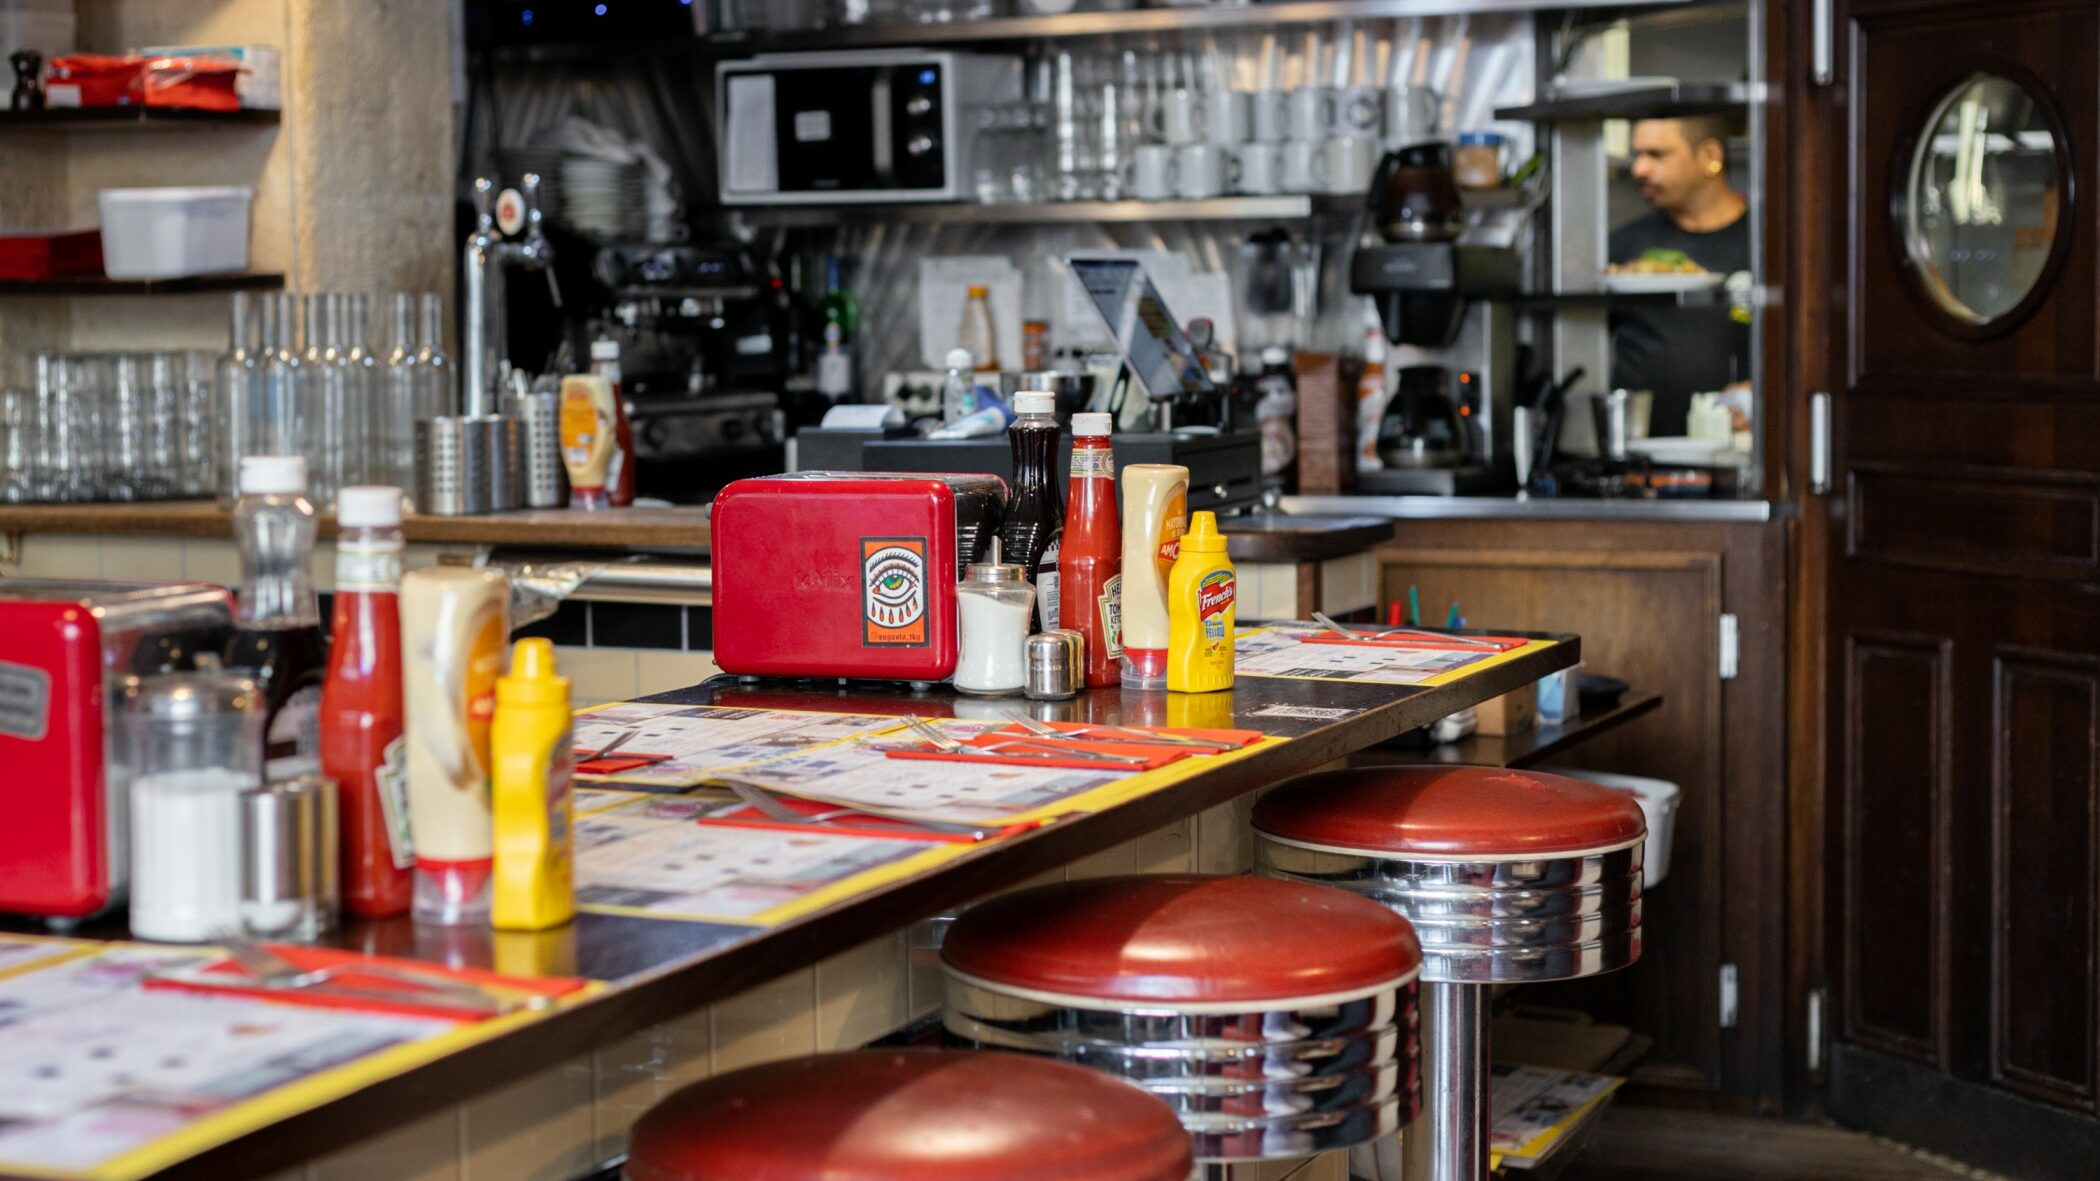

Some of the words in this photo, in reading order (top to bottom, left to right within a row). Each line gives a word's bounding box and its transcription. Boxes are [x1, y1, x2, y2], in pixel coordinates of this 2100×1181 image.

[1160, 542, 1181, 560] AMO
[1111, 583, 1121, 597] HE
[1201, 585, 1233, 611] French's
